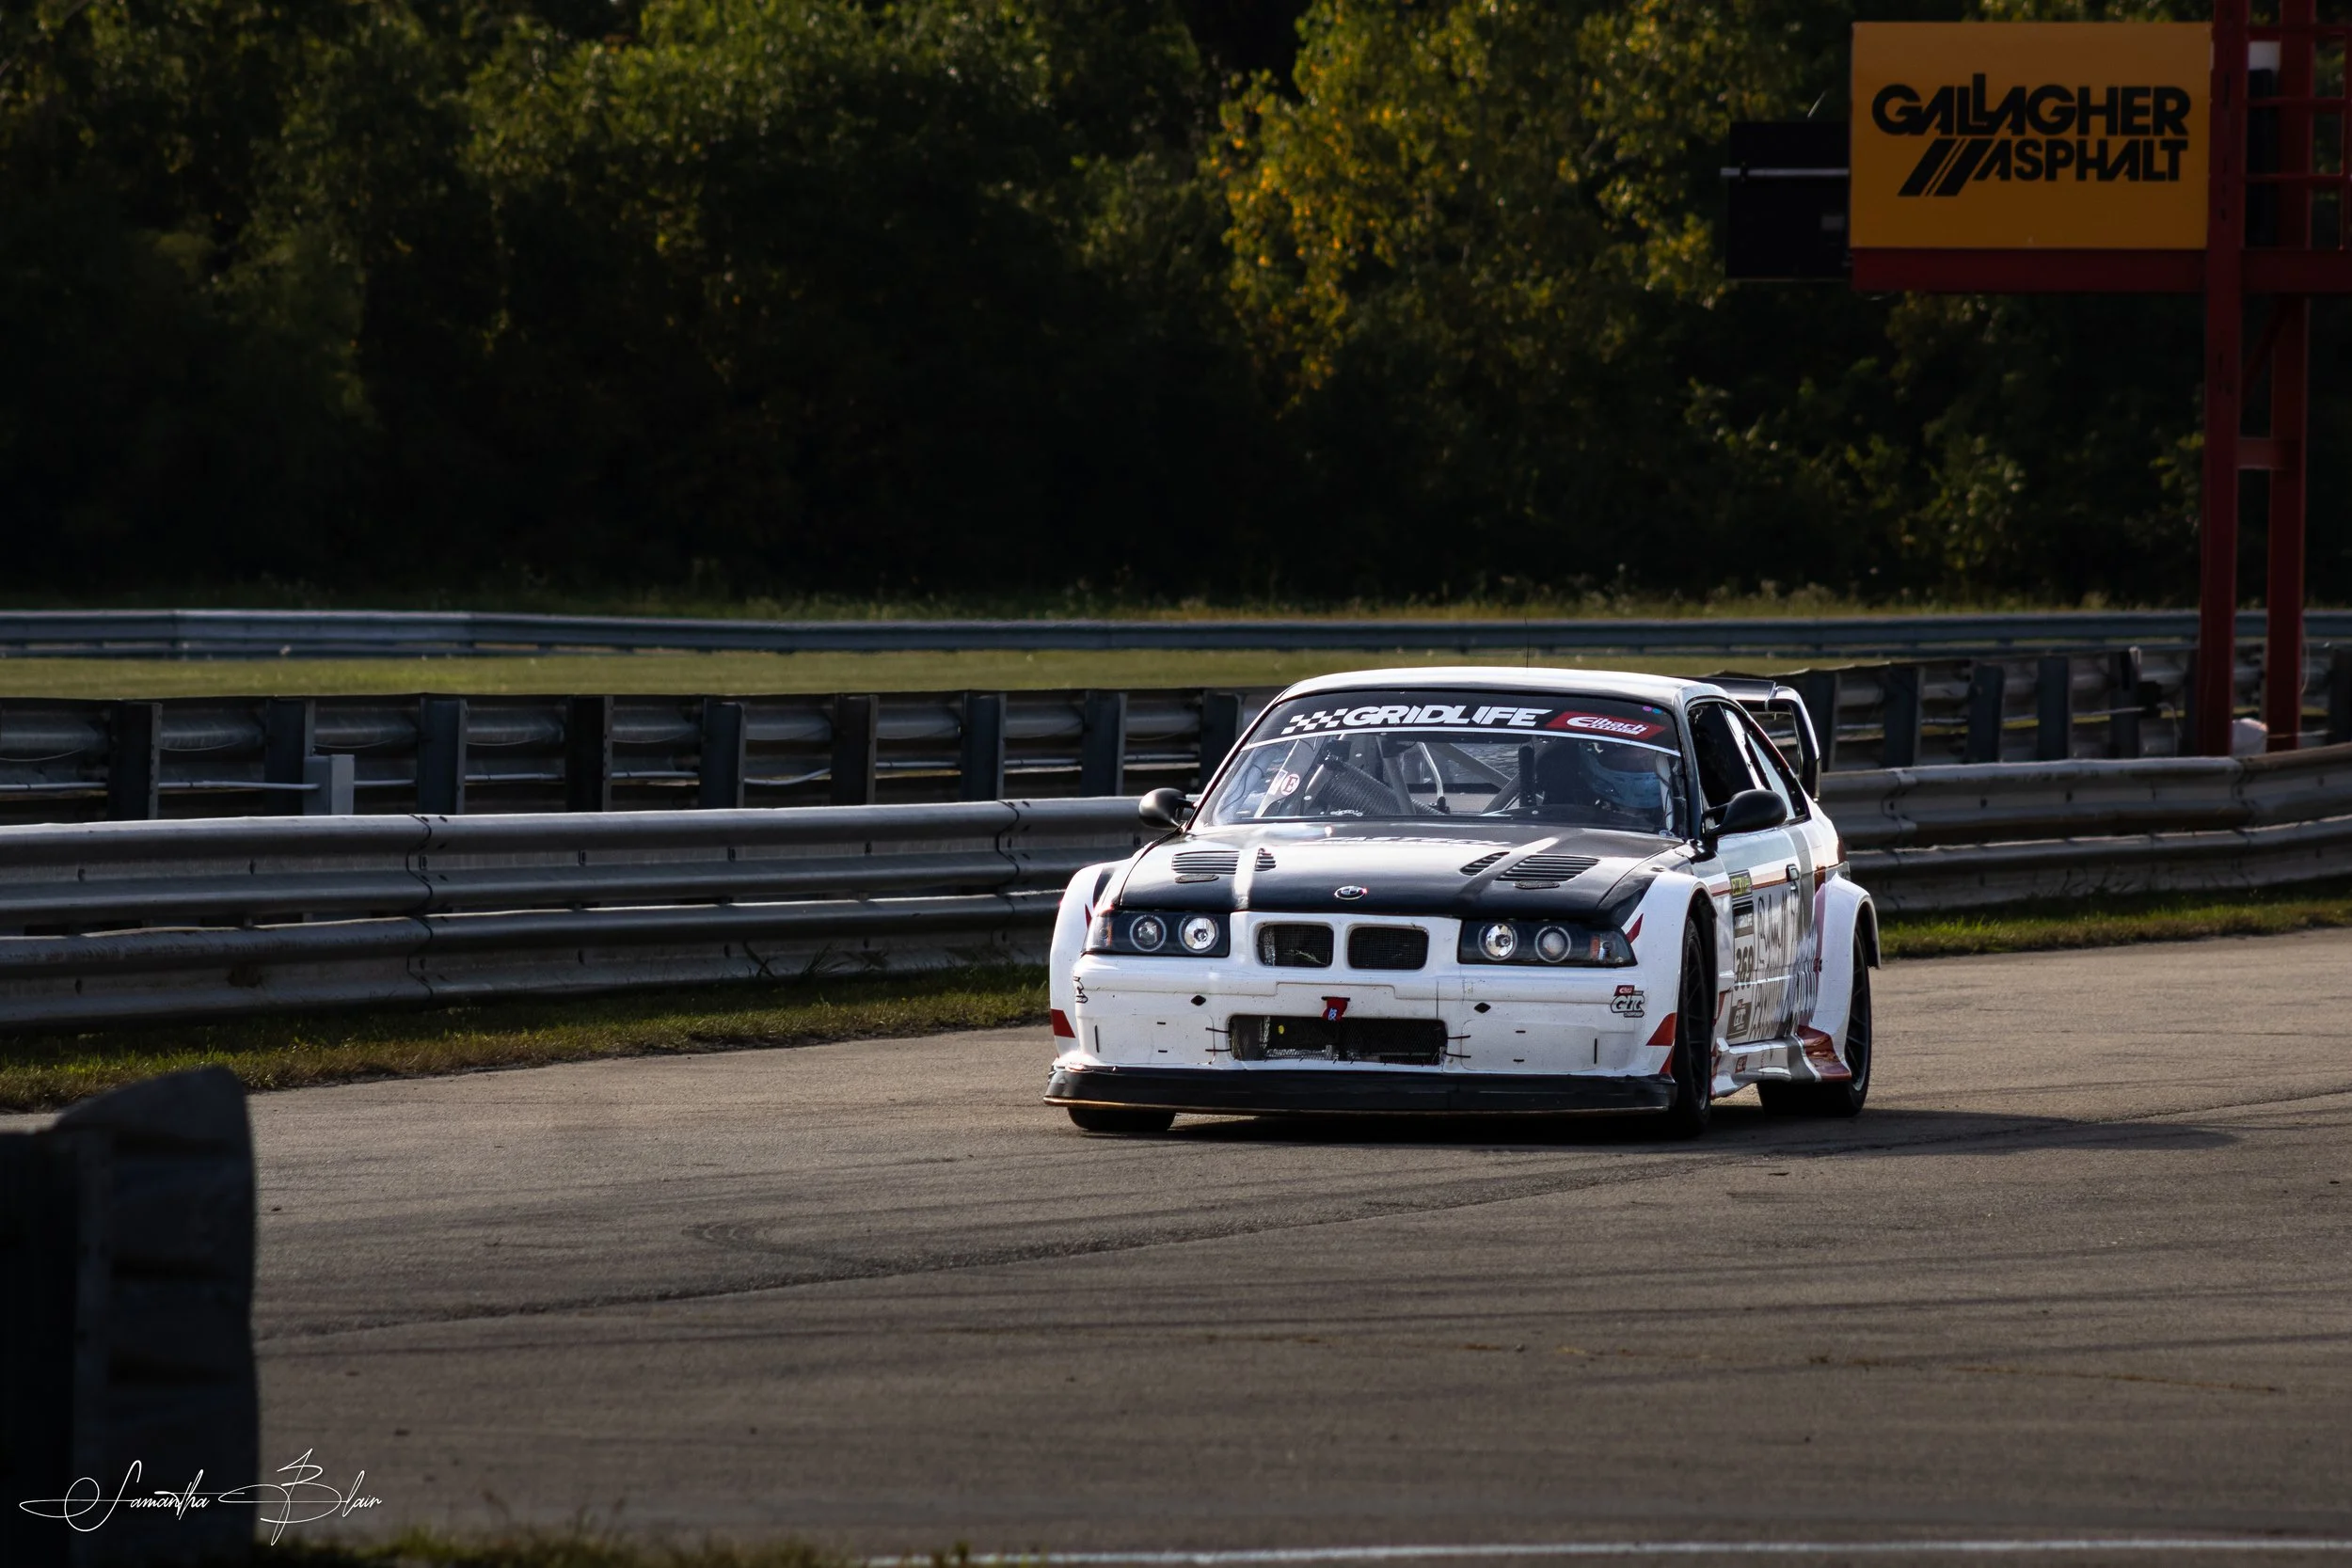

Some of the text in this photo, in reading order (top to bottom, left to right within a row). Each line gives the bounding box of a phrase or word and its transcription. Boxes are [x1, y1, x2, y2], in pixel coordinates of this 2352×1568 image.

[1871, 73, 2191, 136] GALLAGHER
[1972, 138, 2188, 182] ASPHALT
[1342, 705, 1553, 728] GRIDLIFE
